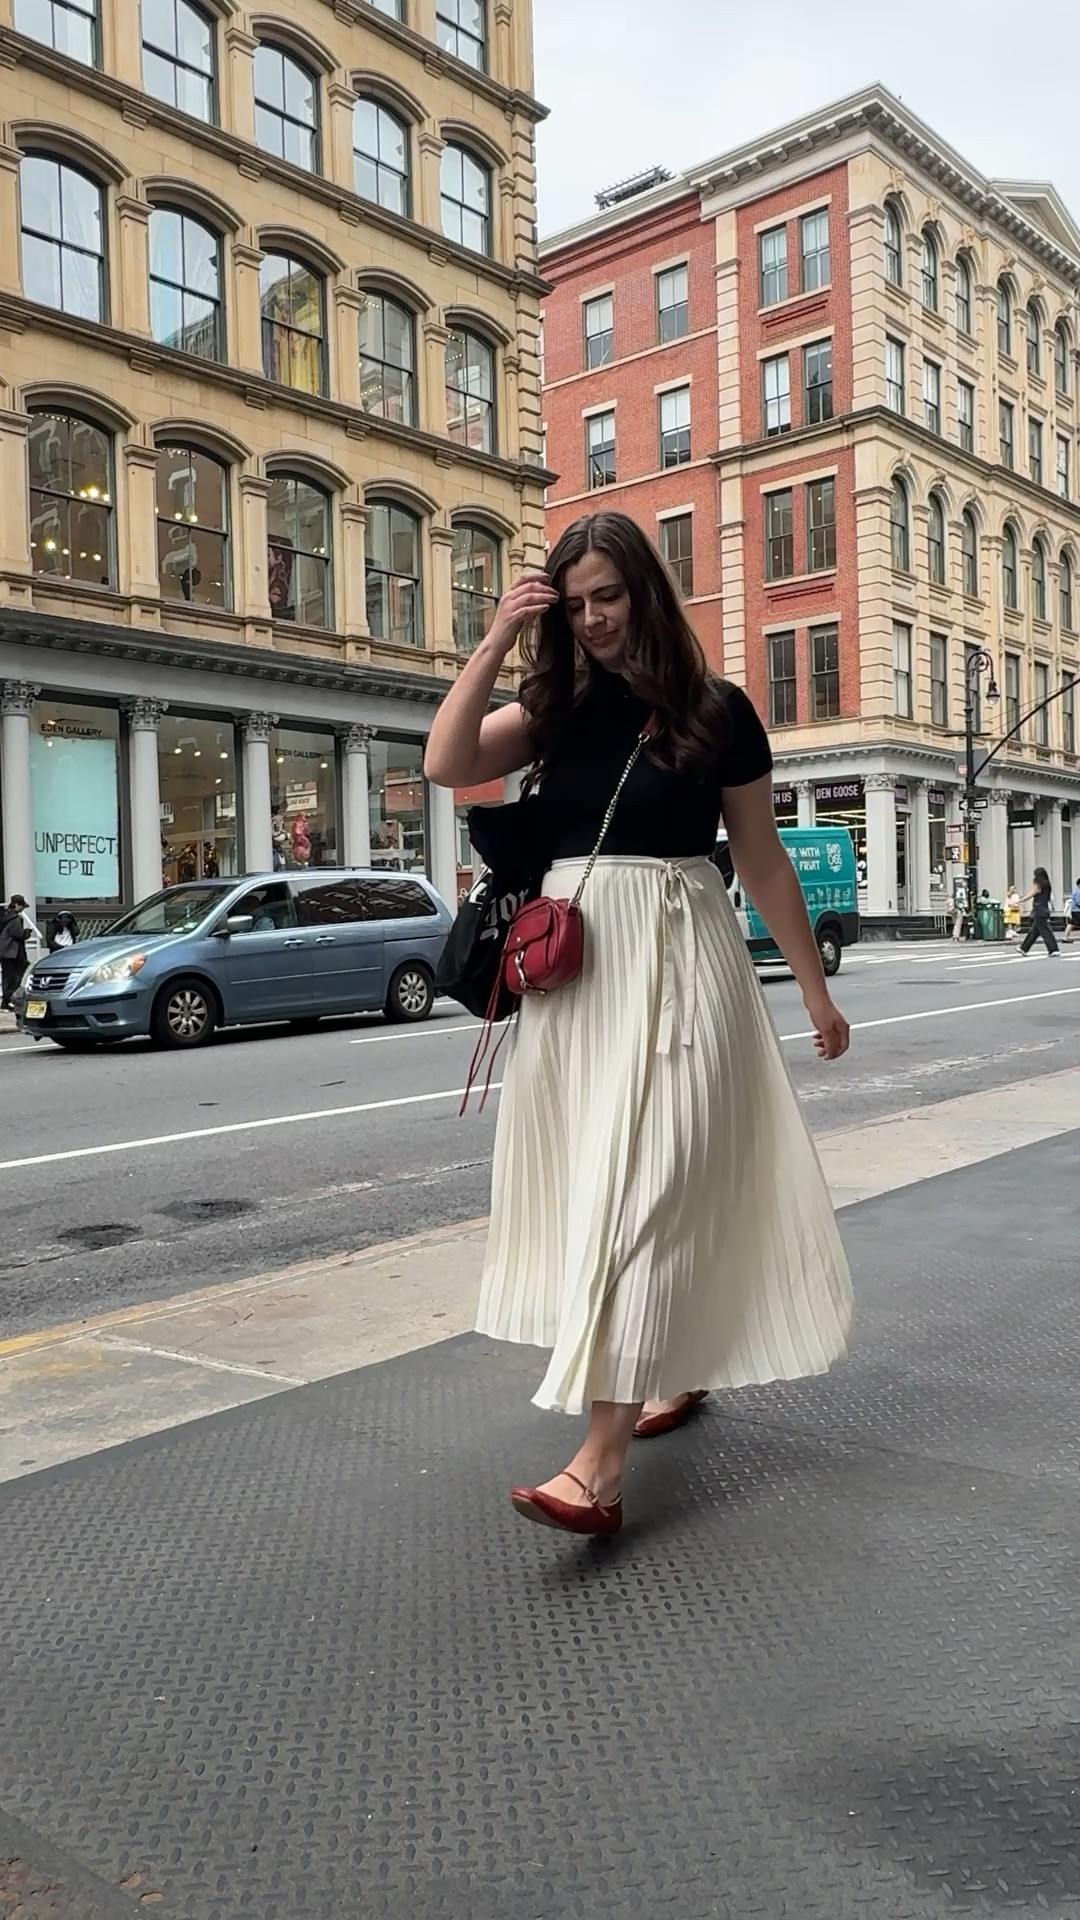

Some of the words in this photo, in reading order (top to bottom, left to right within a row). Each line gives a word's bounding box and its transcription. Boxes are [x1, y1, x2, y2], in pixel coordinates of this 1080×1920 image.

[41, 723, 64, 733] EDEN
[65, 725, 103, 737] GALLERY
[781, 791, 792, 803] US
[833, 784, 859, 798] GOOSE
[34, 831, 117, 855] UNPERFECT
[799, 847, 820, 857] WITH
[58, 859, 79, 876] EP
[799, 860, 820, 871] FRUIT
